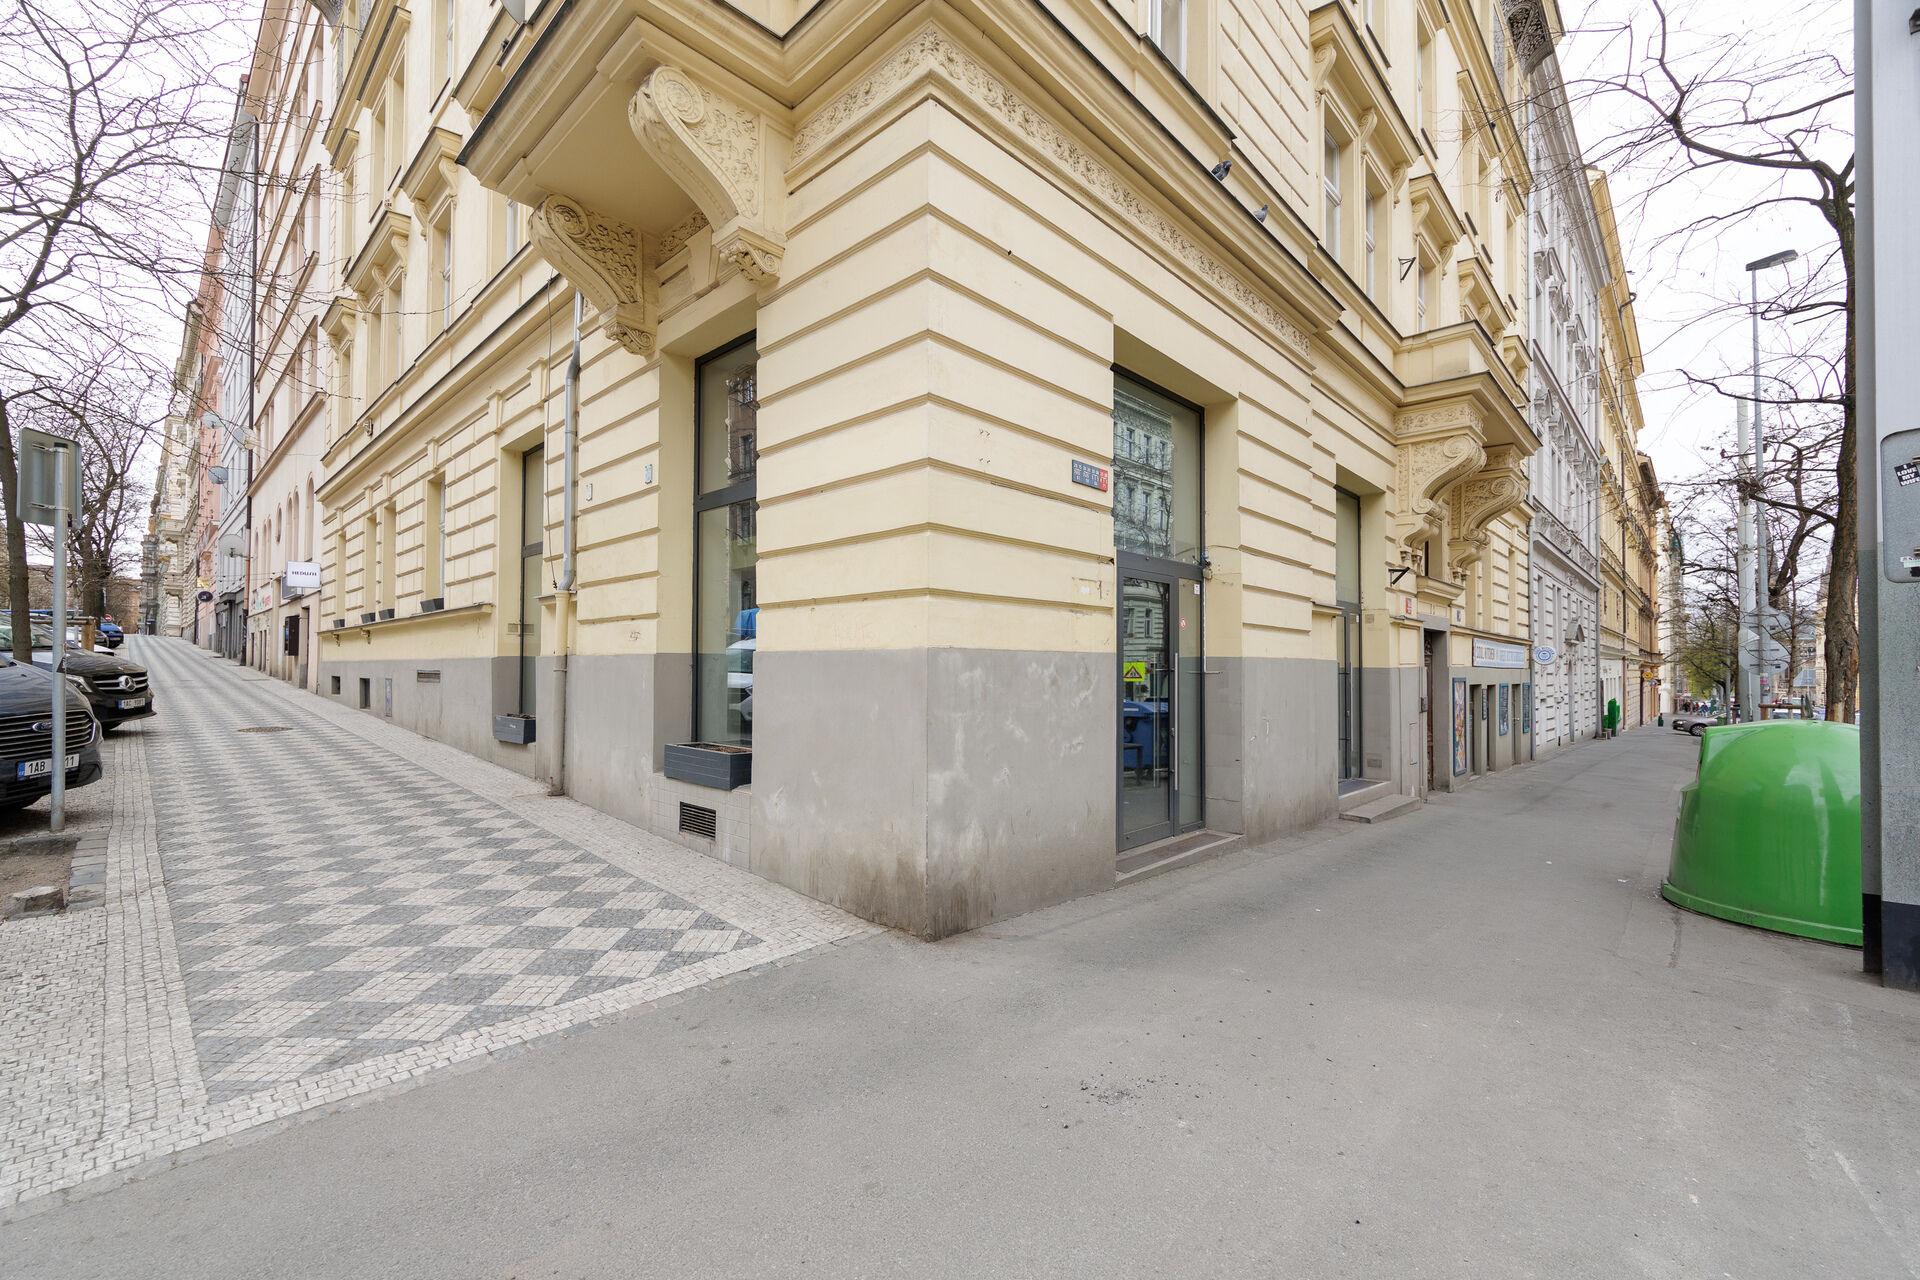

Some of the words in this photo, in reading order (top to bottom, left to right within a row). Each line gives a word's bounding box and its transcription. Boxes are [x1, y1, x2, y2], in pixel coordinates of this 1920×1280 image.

[1897, 467, 1917, 476] LOVE
[1902, 473, 1915, 481] MY
[28, 761, 46, 774] 1AB
